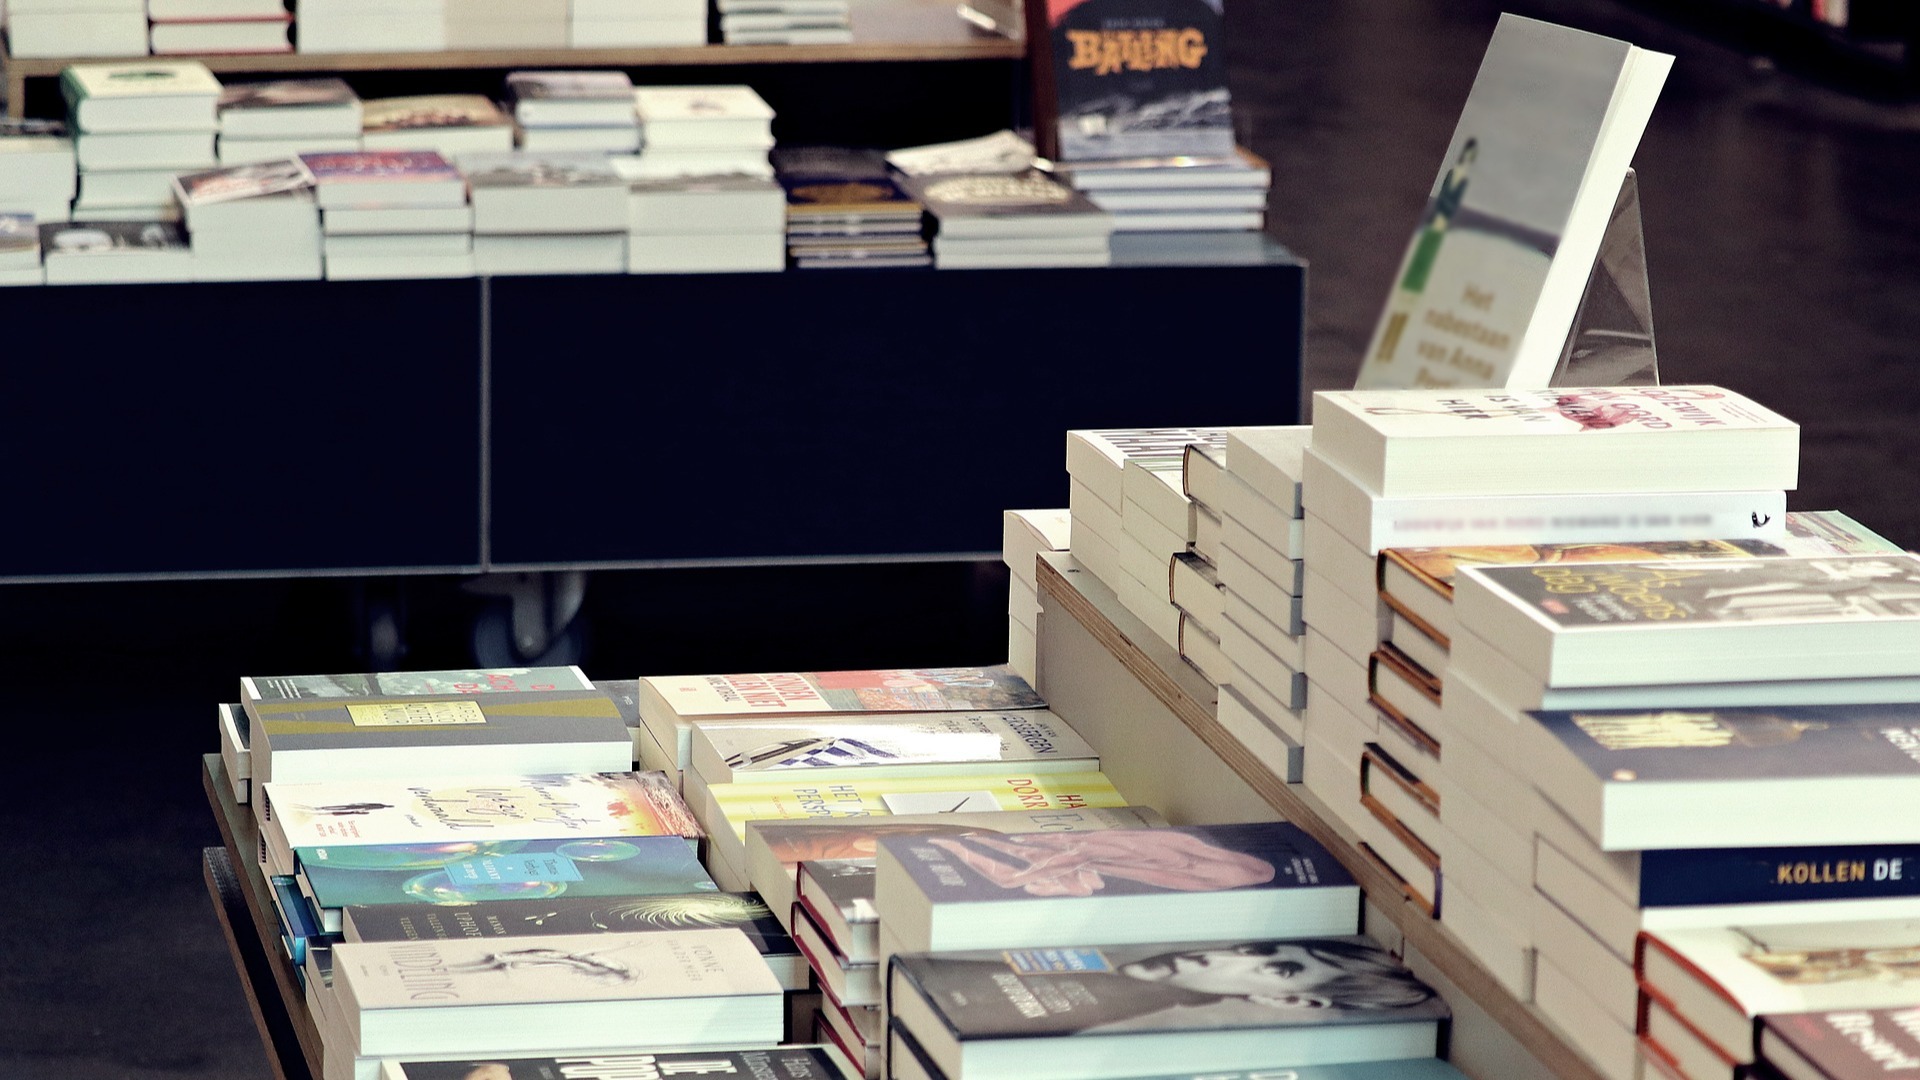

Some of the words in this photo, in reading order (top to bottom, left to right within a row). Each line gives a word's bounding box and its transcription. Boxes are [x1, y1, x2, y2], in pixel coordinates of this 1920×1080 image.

[829, 785, 863, 804] HET
[1776, 861, 1866, 885] KOLLEN
[1872, 858, 1903, 881] DE
[657, 1059, 738, 1076] DE
